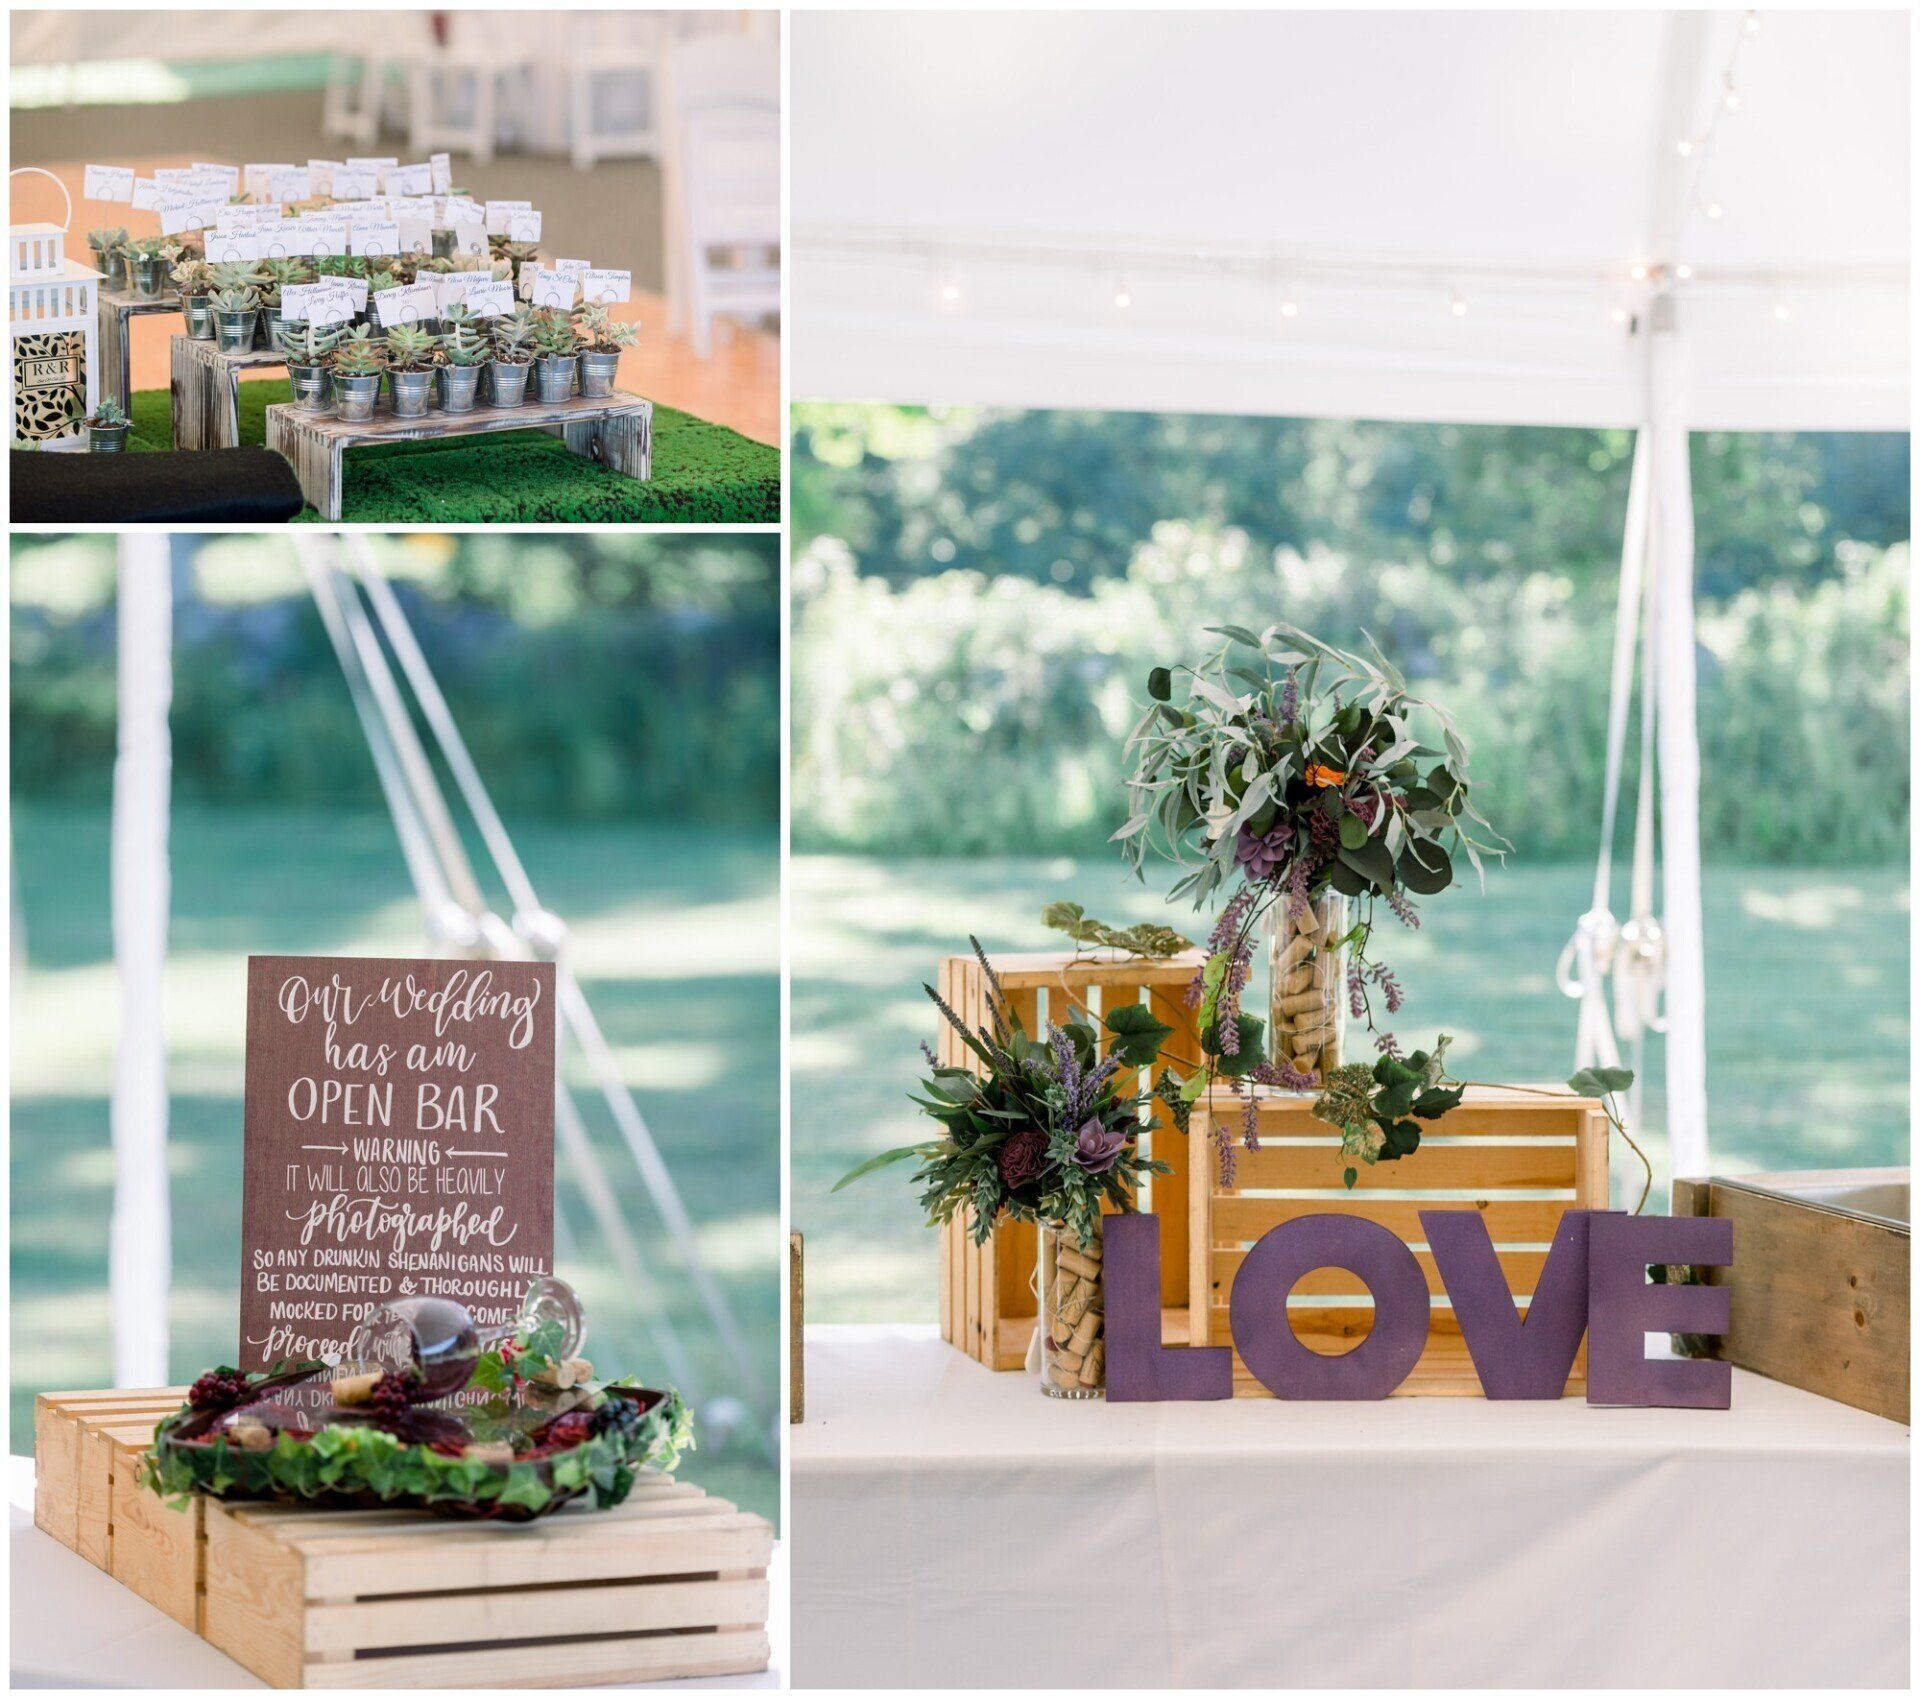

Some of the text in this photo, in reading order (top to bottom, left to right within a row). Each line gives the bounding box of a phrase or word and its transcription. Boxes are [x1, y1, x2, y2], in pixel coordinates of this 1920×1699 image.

[33, 360, 69, 376] R & R
[278, 973, 372, 1026] Our
[324, 1021, 397, 1077] has
[287, 1076, 505, 1135] OPEN BAR
[353, 1137, 441, 1166] WARNING
[286, 1164, 301, 1192] IT
[307, 1165, 349, 1193] WILL
[407, 1166, 429, 1194] BE
[284, 1193, 518, 1254] photographed
[252, 1248, 549, 1276] SO ANY DRUNKIN SHENANIGANS WILL
[256, 1271, 535, 1300] BE DOCUMENTED & THOROUGHLY
[269, 1300, 338, 1321] MOCKED
[1103, 1209, 1734, 1410] LOVE
[246, 1323, 366, 1363] proceed
